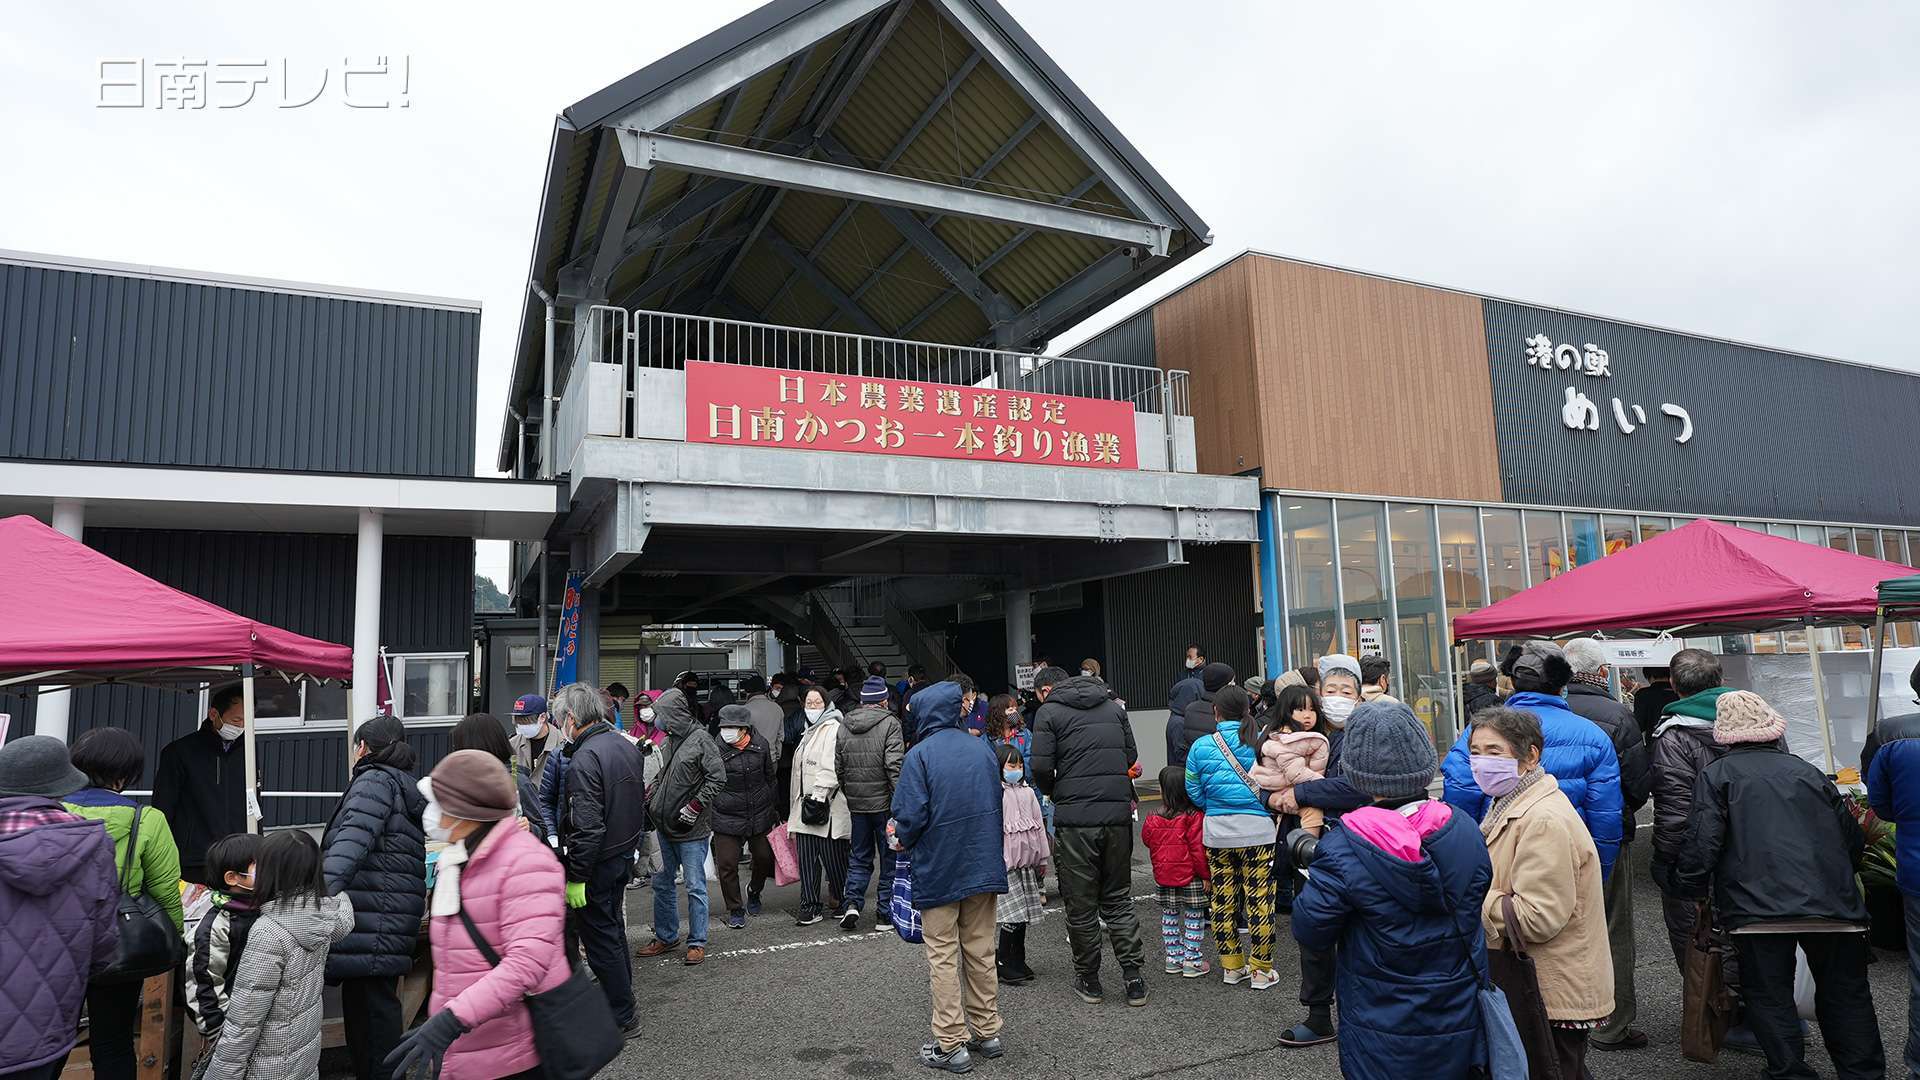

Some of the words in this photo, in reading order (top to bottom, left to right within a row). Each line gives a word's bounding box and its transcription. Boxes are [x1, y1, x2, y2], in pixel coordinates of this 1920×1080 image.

[1525, 333, 1611, 377] 港の駅
[779, 375, 1067, 425] 日本農業遺産認定
[1562, 386, 1693, 443] めいつ
[708, 402, 1121, 464] 日南かつお一本釣り漁業
